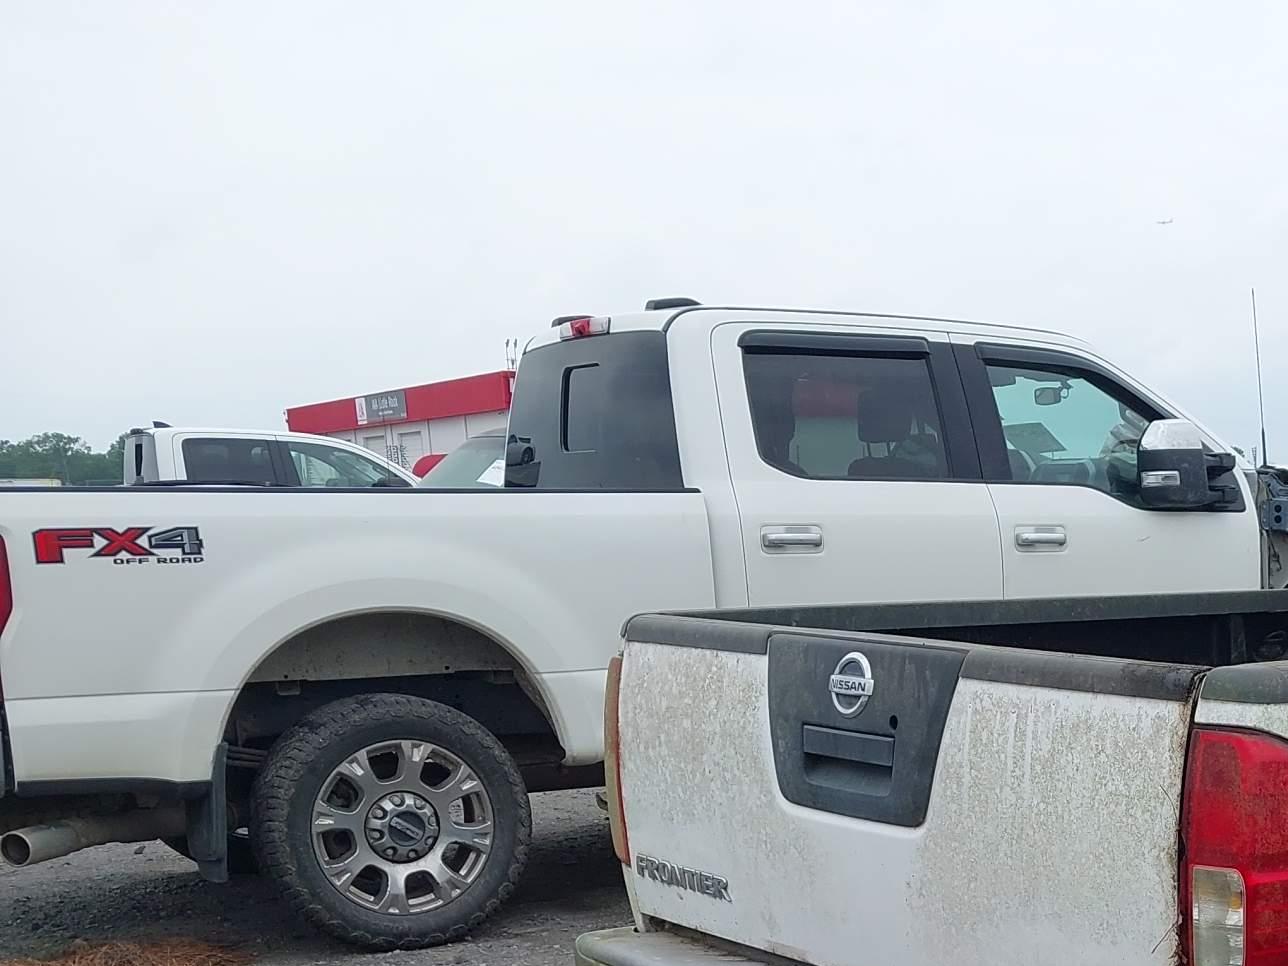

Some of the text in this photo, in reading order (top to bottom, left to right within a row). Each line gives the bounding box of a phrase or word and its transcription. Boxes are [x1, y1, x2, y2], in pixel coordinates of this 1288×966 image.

[32, 526, 204, 565] FX4
[831, 678, 866, 692] NISSAN
[635, 853, 732, 902] FRONTIER
